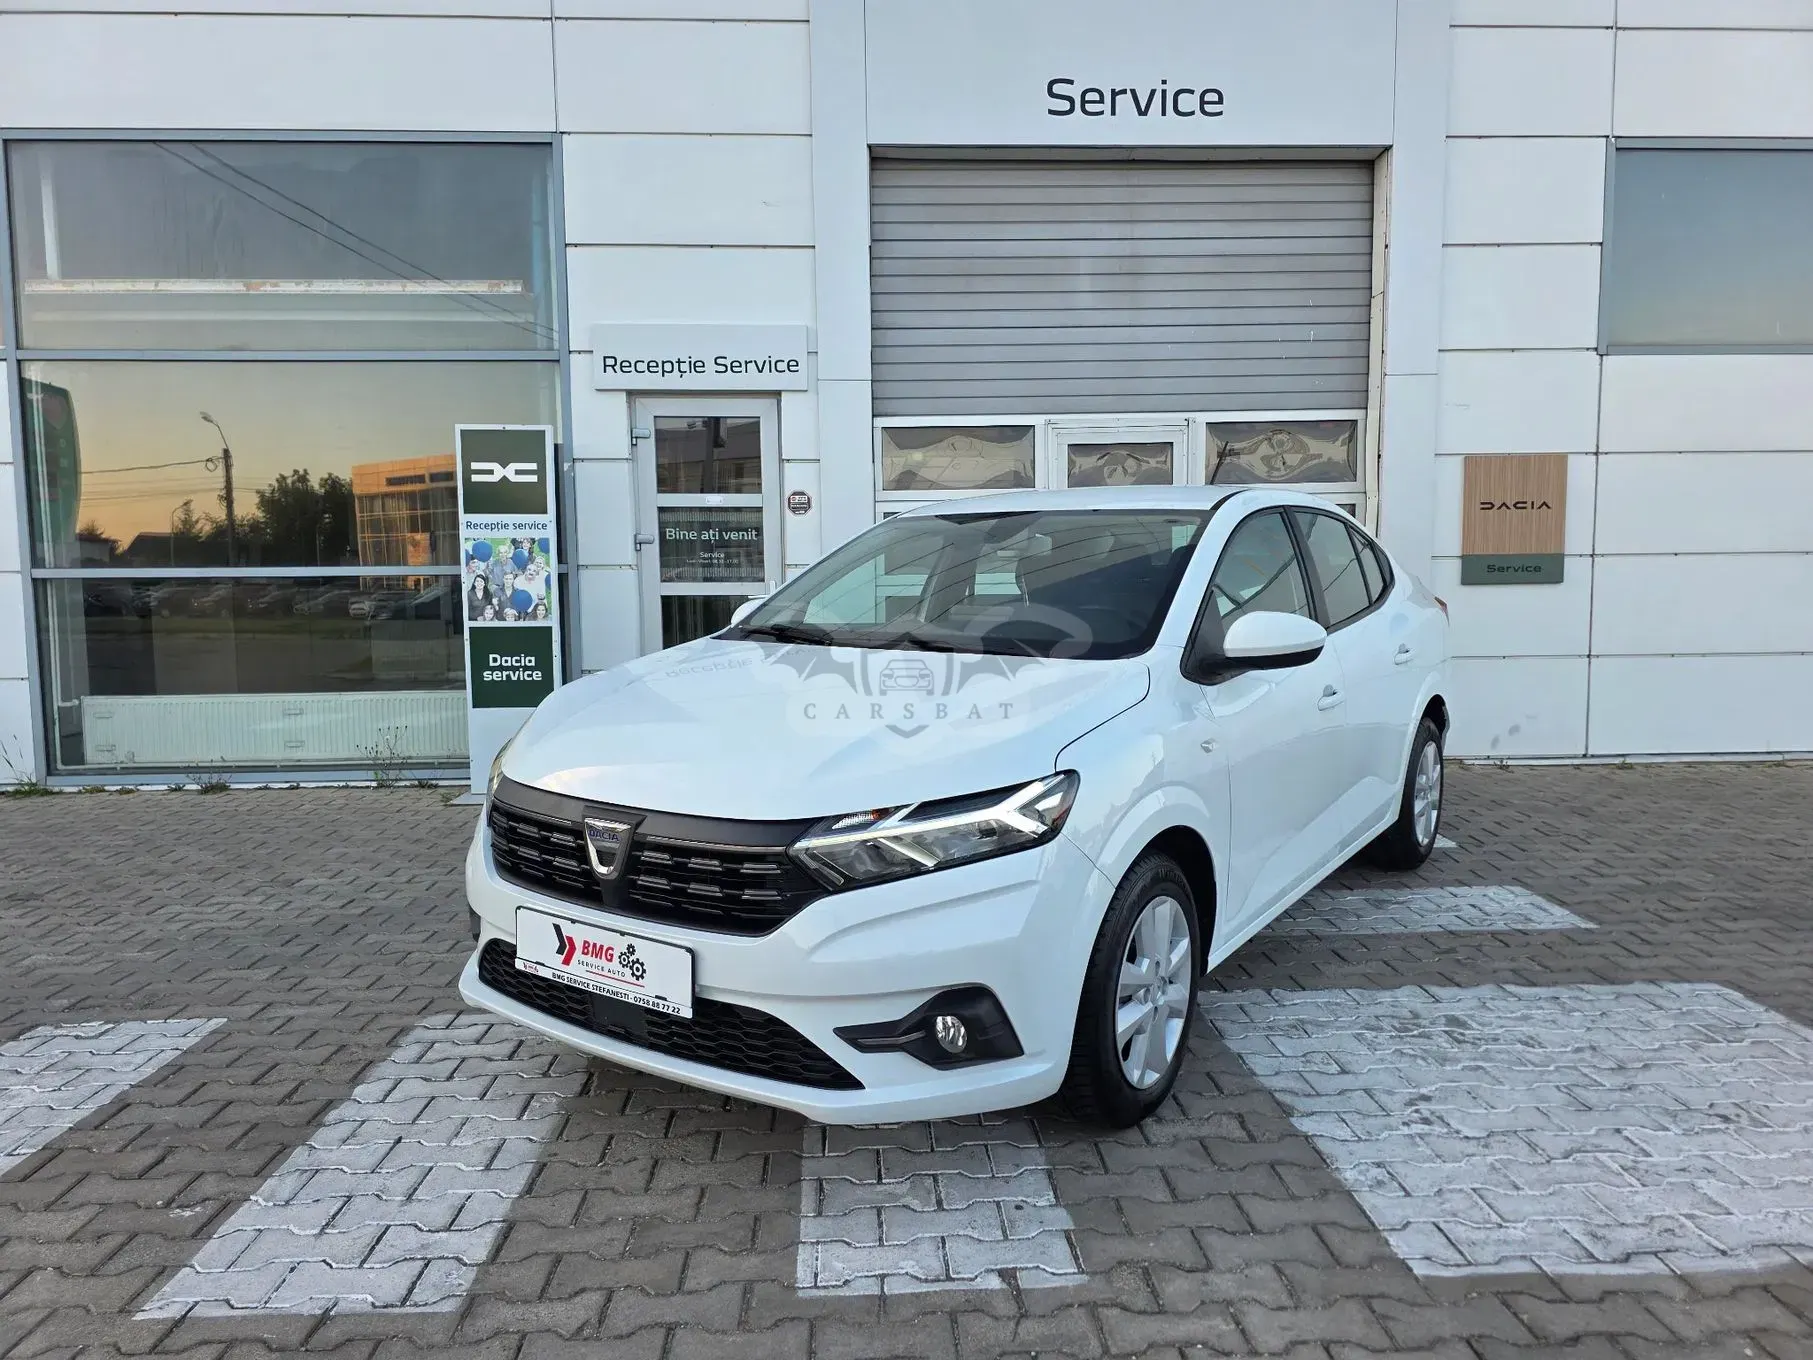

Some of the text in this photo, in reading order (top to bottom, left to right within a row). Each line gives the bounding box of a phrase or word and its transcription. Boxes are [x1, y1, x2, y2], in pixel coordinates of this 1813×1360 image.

[1047, 78, 1224, 117] Service
[602, 355, 800, 378] Recepție Service
[1480, 500, 1551, 511] DACIA
[465, 520, 548, 533] Recepție service
[665, 528, 697, 540] Bine
[722, 529, 758, 540] venit
[1487, 564, 1542, 573] Service
[489, 654, 535, 667] Dacia
[483, 668, 542, 681] service
[589, 829, 619, 842] DACIA
[581, 939, 615, 963] BMG
[577, 960, 626, 978] SERVICE AUTO
[551, 972, 566, 982] BMG
[566, 976, 591, 989] SERVICE
[592, 984, 630, 1000] STEFANESTI
[633, 996, 651, 1008] 0758
[651, 1000, 661, 1010] 88
[661, 1003, 671, 1012] 77
[671, 1005, 681, 1014] 22
